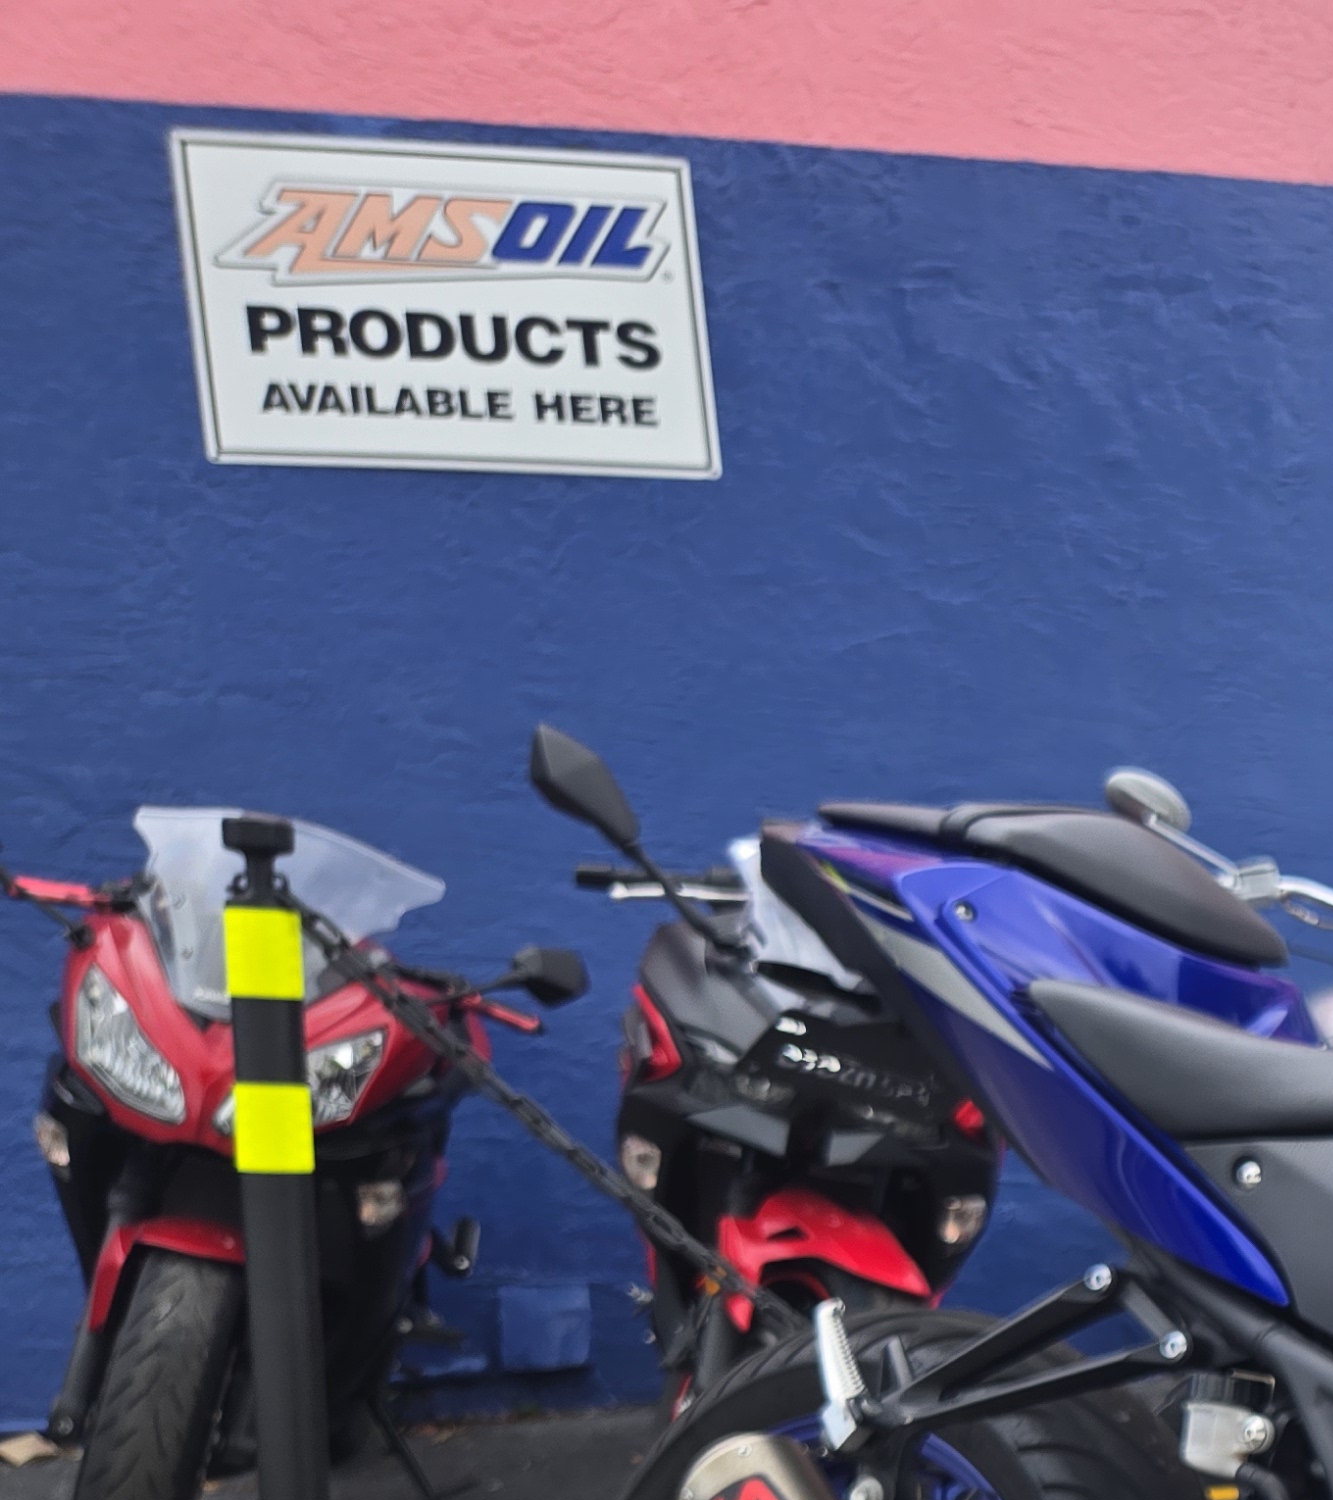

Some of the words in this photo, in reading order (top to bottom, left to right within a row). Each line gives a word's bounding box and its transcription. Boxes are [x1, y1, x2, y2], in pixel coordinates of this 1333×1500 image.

[242, 187, 657, 275] AMSOIL
[246, 305, 662, 371] PRODUCTS
[260, 382, 516, 421] AVAILABLE
[533, 392, 660, 427] HERE
